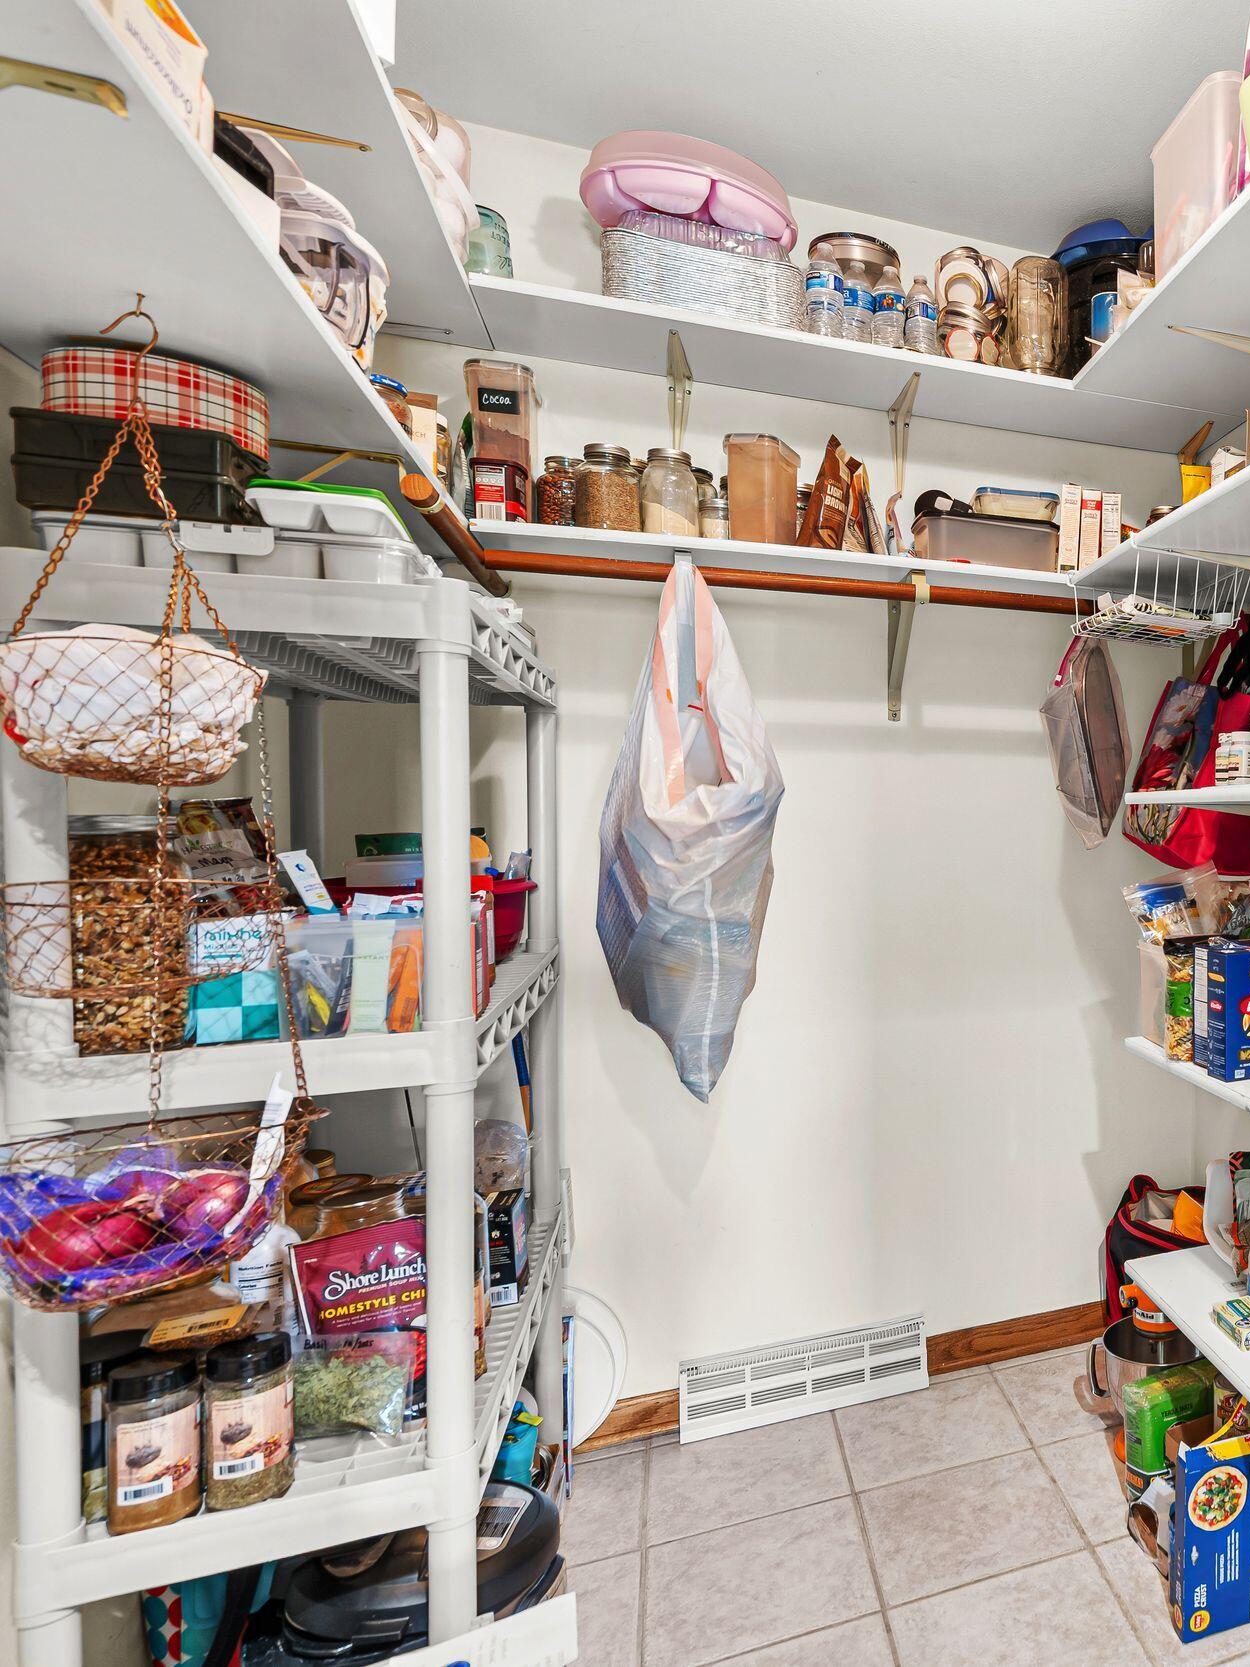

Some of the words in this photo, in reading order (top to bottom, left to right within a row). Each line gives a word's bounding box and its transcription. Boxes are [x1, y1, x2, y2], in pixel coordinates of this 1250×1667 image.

[482, 393, 512, 405] Cocoa
[826, 484, 843, 500] LIGHT
[824, 496, 848, 515] BROWN
[238, 1262, 264, 1272] Nutrition
[324, 1270, 381, 1301] Shore
[381, 1258, 426, 1284] Lunch
[358, 1283, 387, 1294] PREMIUM
[388, 1280, 408, 1288] SOUP
